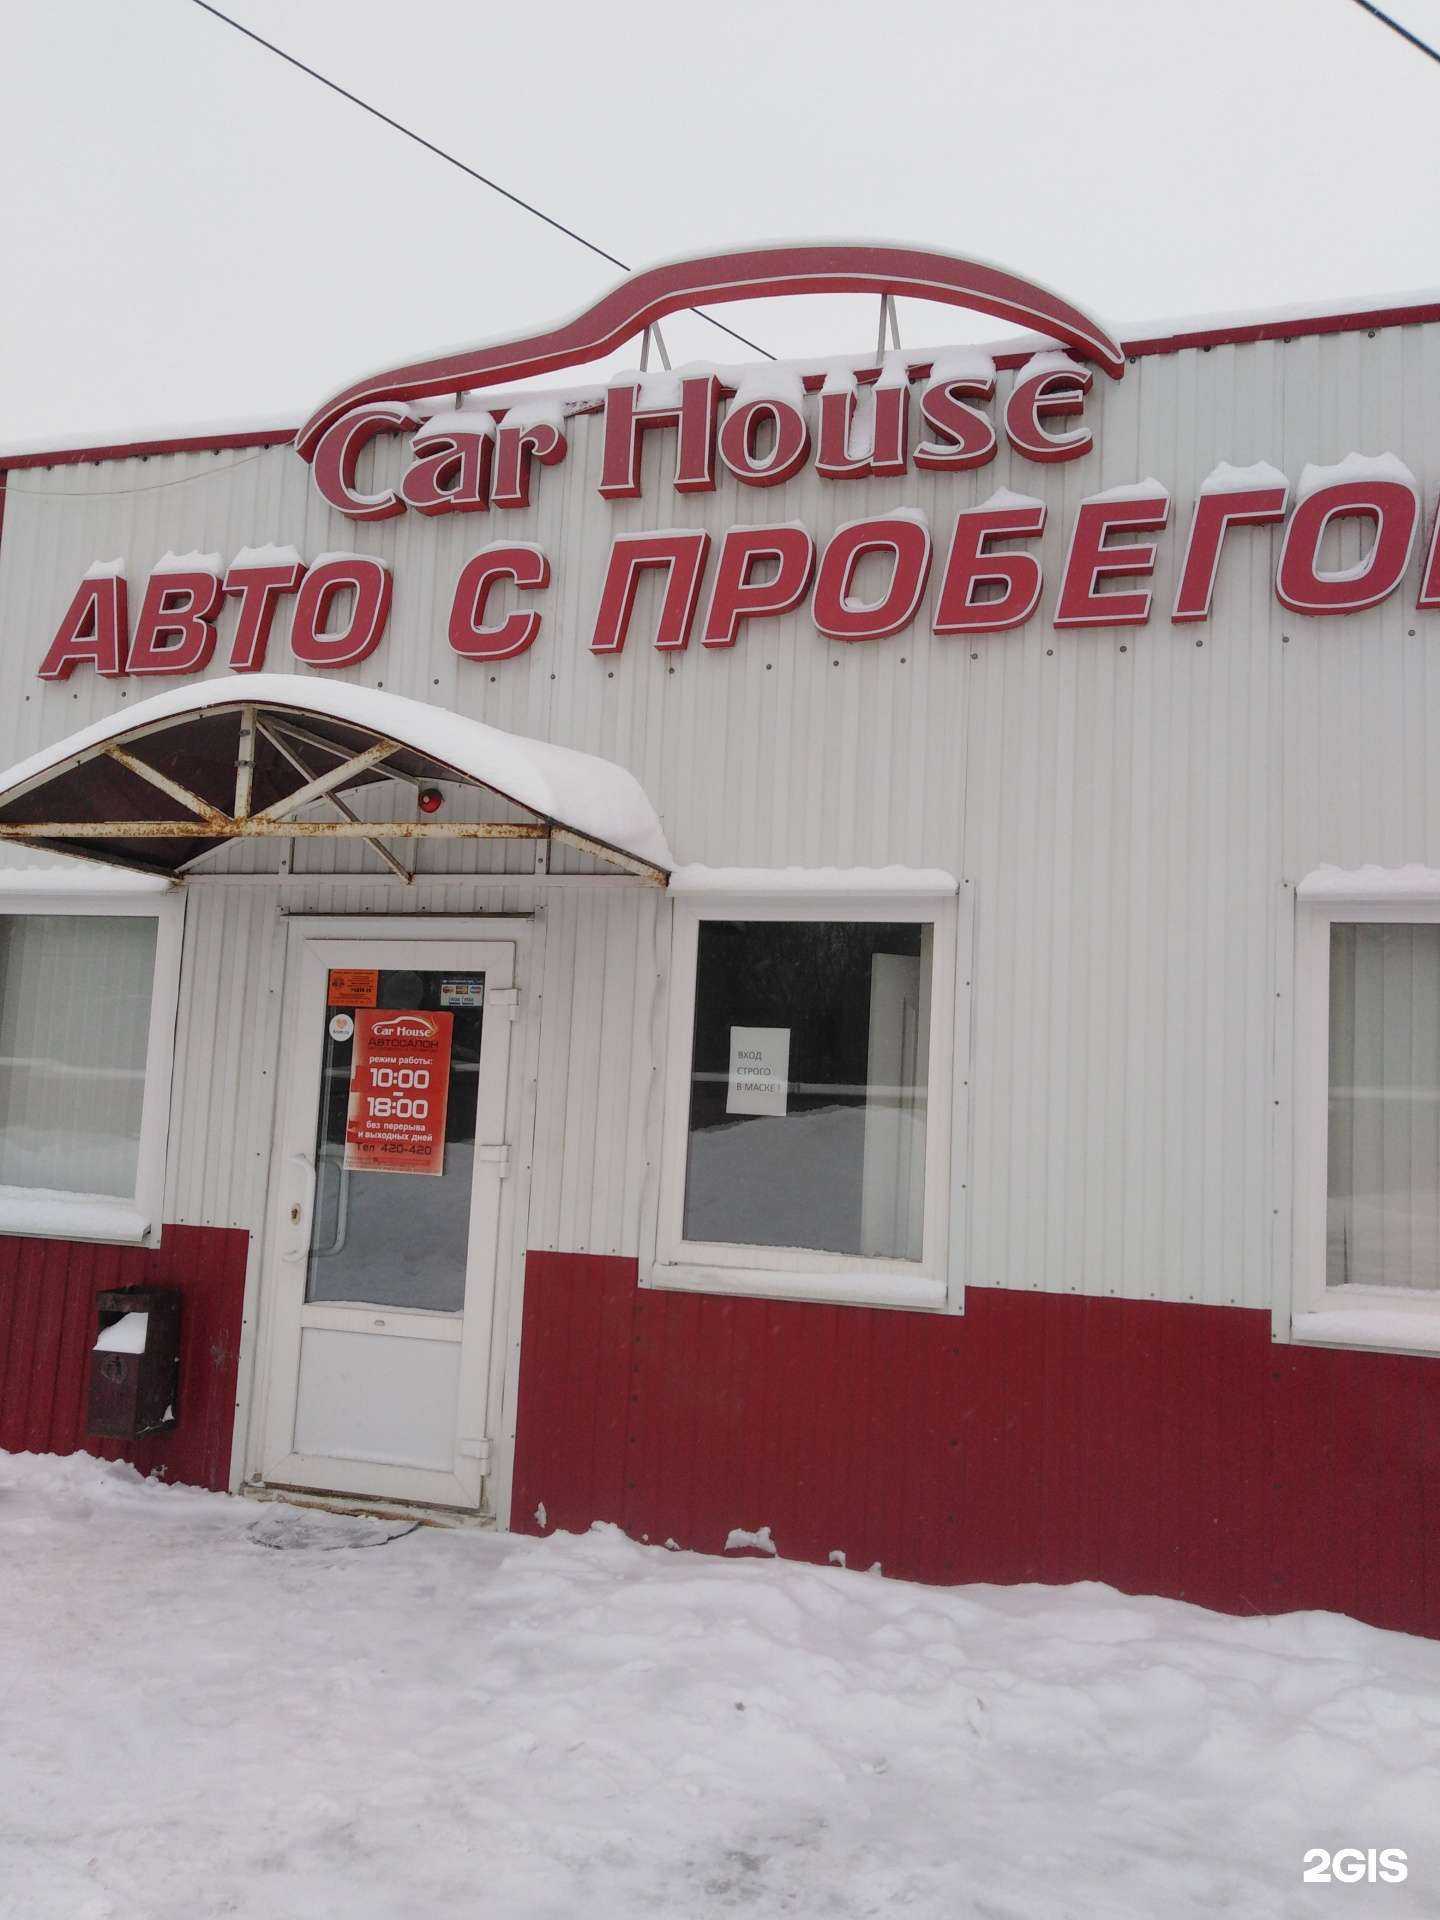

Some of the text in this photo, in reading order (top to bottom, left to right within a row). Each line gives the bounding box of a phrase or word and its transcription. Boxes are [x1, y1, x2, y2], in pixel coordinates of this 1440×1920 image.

[312, 363, 1094, 522] Car House
[37, 478, 1440, 681] АВТО С ПРОБЕГО
[373, 1025, 432, 1038] Car House
[368, 1038, 439, 1050] АВТОСАЛОН
[369, 1056, 433, 1066] режим работы:
[738, 1051, 763, 1061] ВХОД
[737, 1066, 772, 1076] СТРОГО
[370, 1068, 430, 1089] 10:00
[736, 1082, 742, 1091] В
[367, 1097, 429, 1119] 18:00
[366, 1120, 426, 1133] без перерыва
[365, 1131, 409, 1143] выходных
[410, 1132, 433, 1144] дней
[379, 1143, 432, 1156] 420-420
